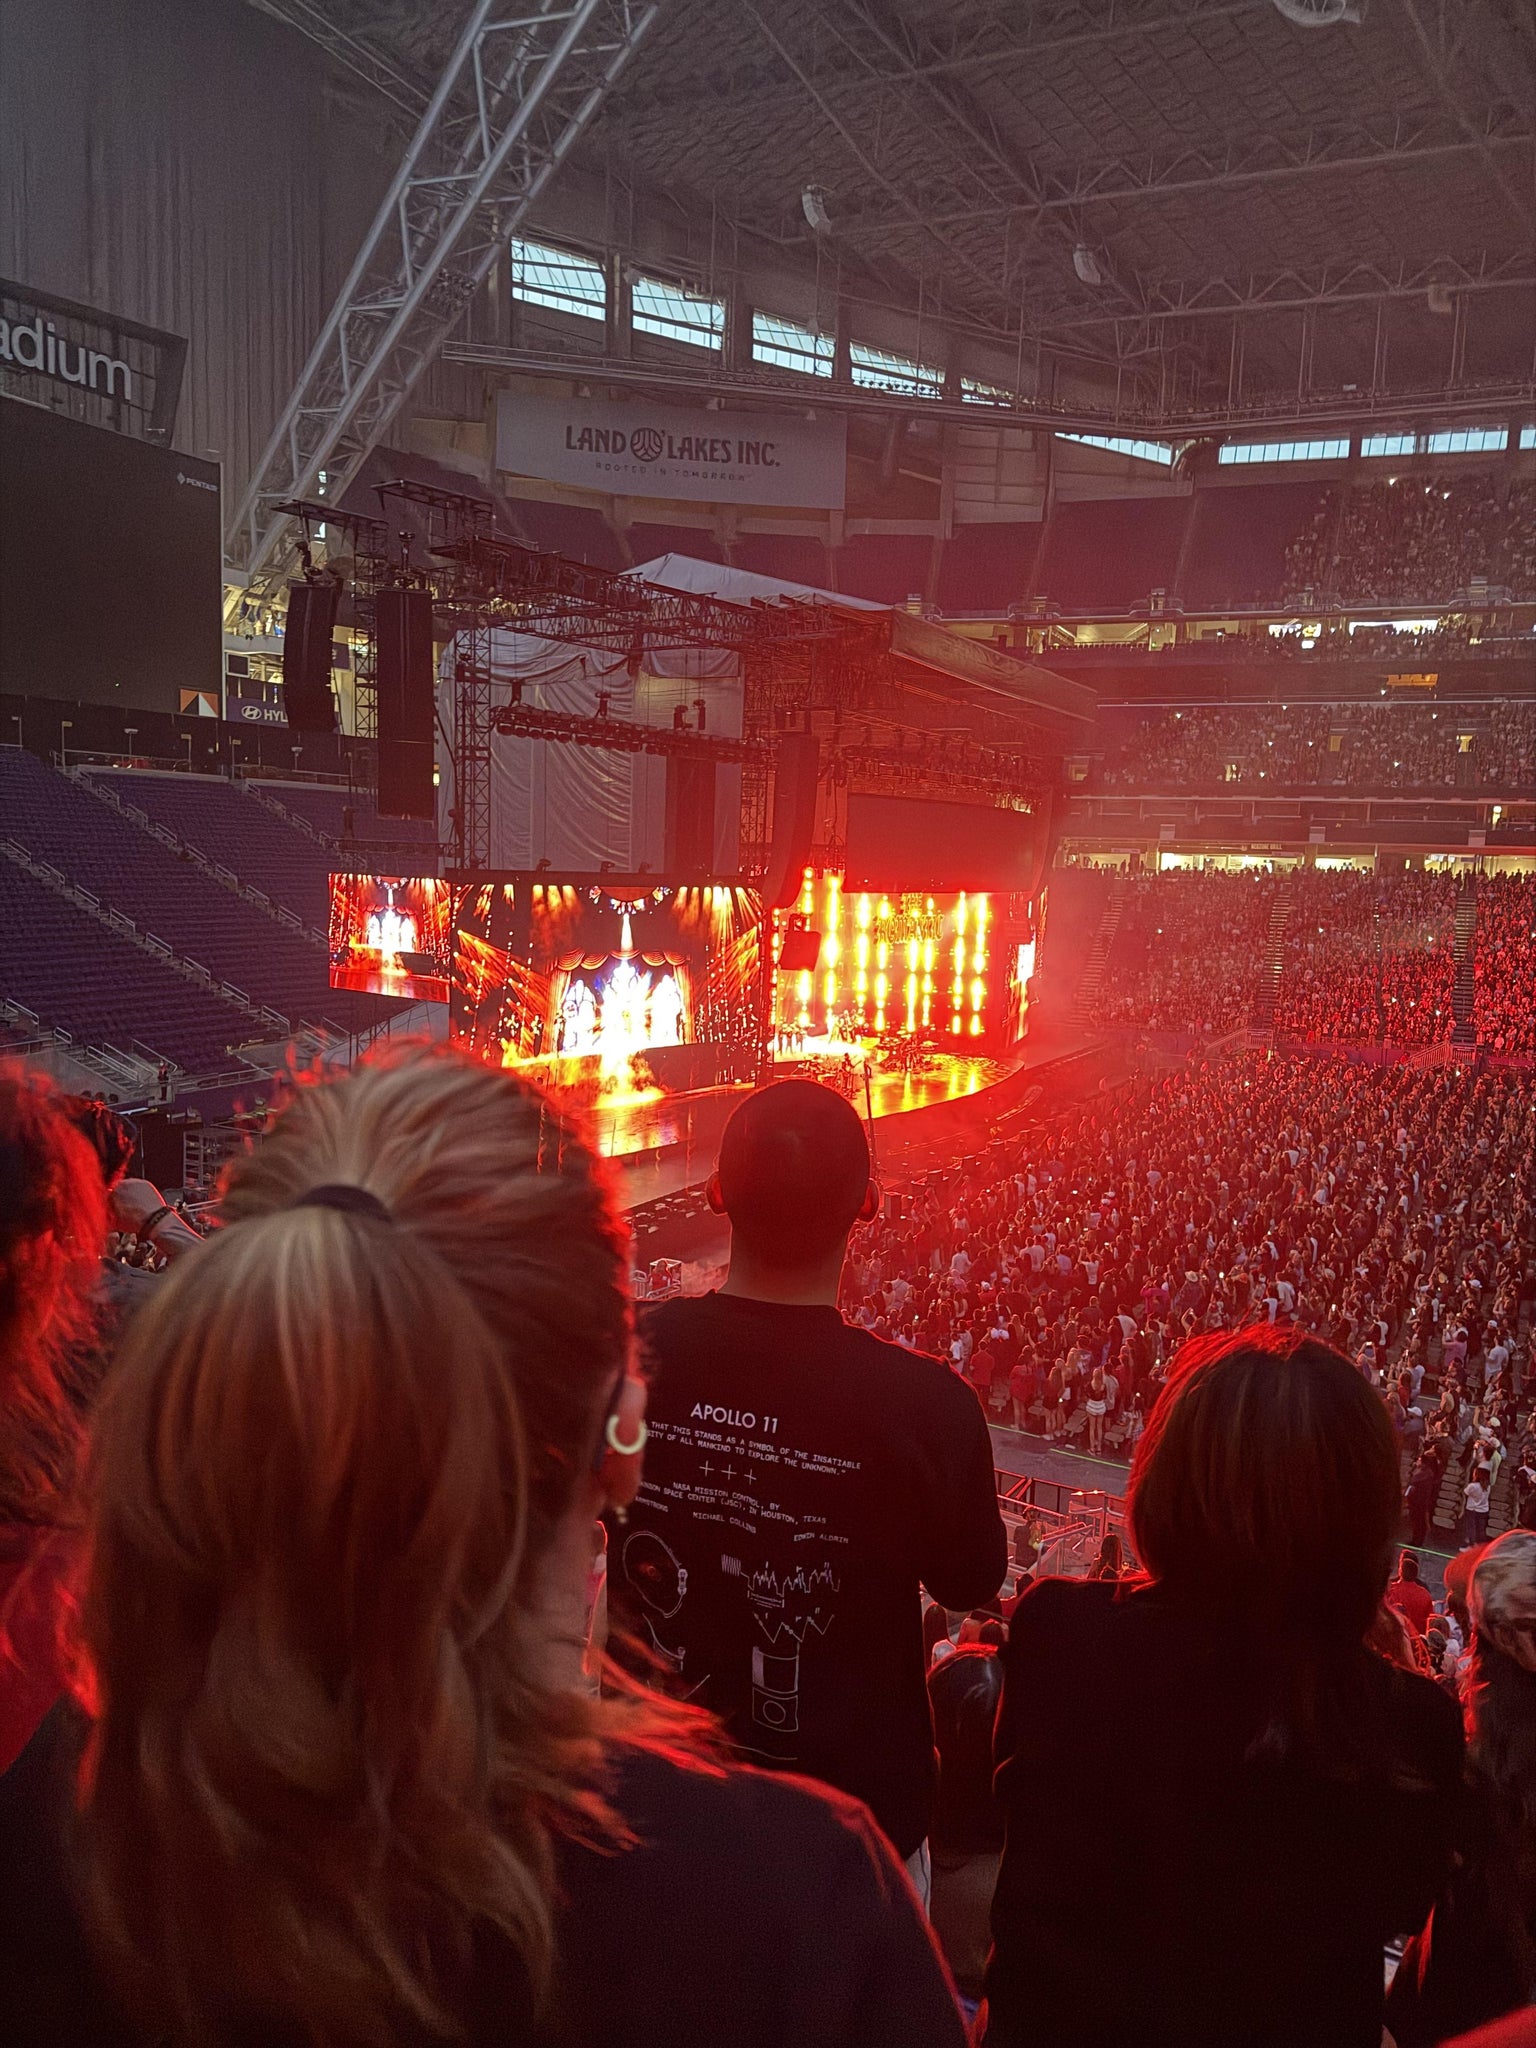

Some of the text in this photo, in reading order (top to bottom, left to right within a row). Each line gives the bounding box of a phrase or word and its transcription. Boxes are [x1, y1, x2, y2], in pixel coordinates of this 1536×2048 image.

[565, 424, 627, 455] LAND
[737, 440, 781, 468] INC.
[595, 463, 647, 475] ROOTED
[653, 467, 667, 476] IN
[690, 1402, 778, 1434] APOLLO 11
[651, 1421, 669, 1431] THAT
[672, 1425, 691, 1436] THIS
[694, 1430, 722, 1442] STANDS
[726, 1436, 736, 1444] AS
[748, 1440, 776, 1453] SYMBOL
[779, 1447, 790, 1455] OF
[794, 1449, 809, 1460] THE
[812, 1453, 861, 1470] INSATIABLE
[667, 1433, 676, 1441] OF
[679, 1436, 694, 1446] ALL
[697, 1440, 731, 1452] MANKIND
[735, 1446, 745, 1455] TO
[748, 1450, 780, 1463] EXPLORE
[783, 1457, 798, 1467] THE
[663, 1487, 683, 1499] SPACE
[687, 1493, 716, 1504] CENTER
[760, 1509, 799, 1526] HOUSTON,
[802, 1515, 826, 1525] TEXAS
[672, 1481, 691, 1492] NASA
[694, 1486, 728, 1498] MISSION
[769, 1502, 780, 1511] BY
[692, 1511, 757, 1534] MICHAEL COLLINS
[819, 1533, 849, 1544] ALDRIN
